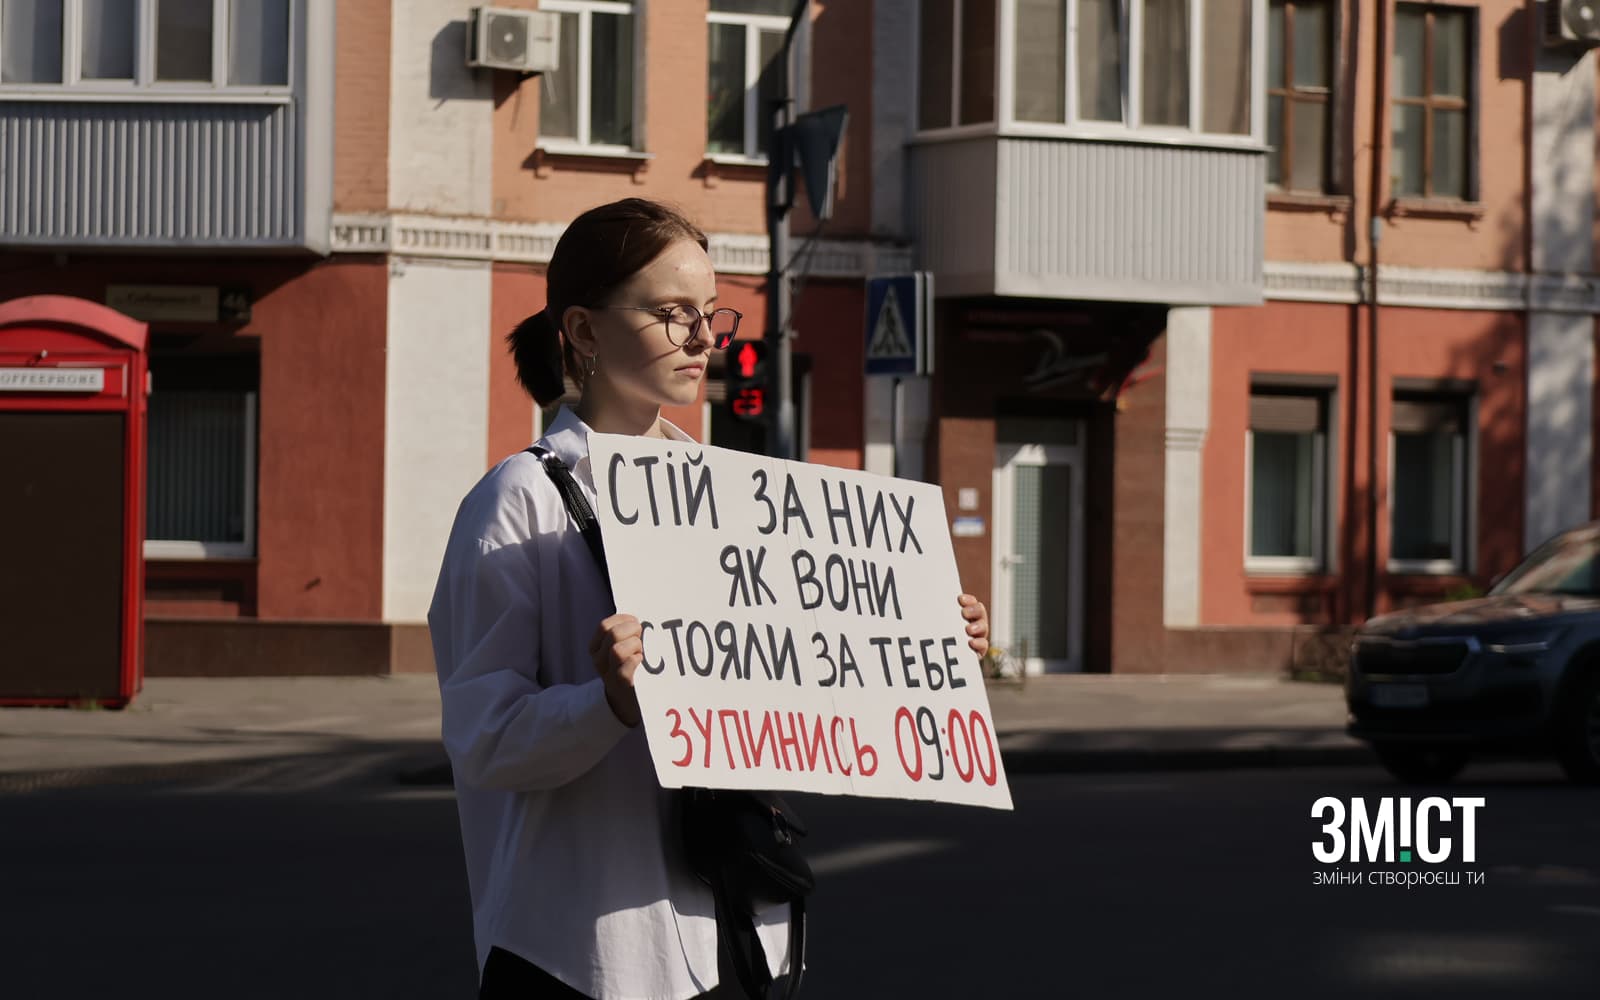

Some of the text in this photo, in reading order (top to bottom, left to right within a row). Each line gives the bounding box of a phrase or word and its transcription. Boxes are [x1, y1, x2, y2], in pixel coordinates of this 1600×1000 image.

[0, 372, 97, 385] OFFEEPHONE
[752, 469, 814, 539] ЗА
[820, 478, 923, 554] НИХ
[720, 545, 902, 620] ЯК ВОНИ
[641, 619, 967, 692] СТОЯЛИ ЗА ТЕБЕ
[665, 706, 997, 786] ЗУПИНИСЬ 09:00
